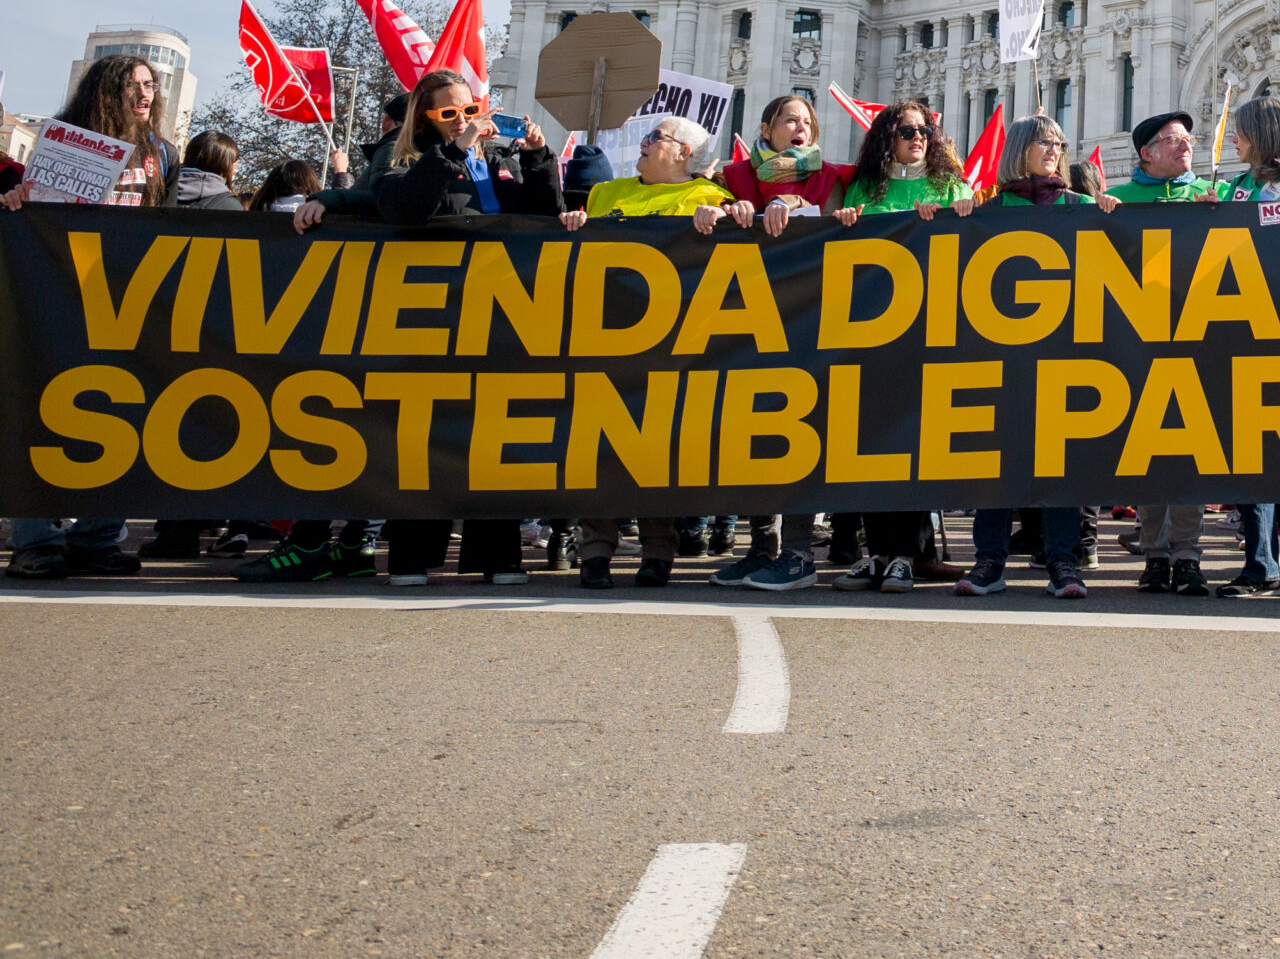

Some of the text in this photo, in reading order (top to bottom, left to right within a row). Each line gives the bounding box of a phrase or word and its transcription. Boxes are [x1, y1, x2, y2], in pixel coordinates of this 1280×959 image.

[697, 93, 728, 136] YA!
[44, 126, 111, 154] Militante
[30, 167, 53, 187] LAS
[54, 175, 104, 202] CALLES
[34, 154, 54, 172] HAY
[54, 160, 74, 178] QUE
[74, 166, 111, 189] TOMAR
[67, 232, 789, 359] VIVIENDA
[29, 360, 1004, 491] SOSTENIBLE
